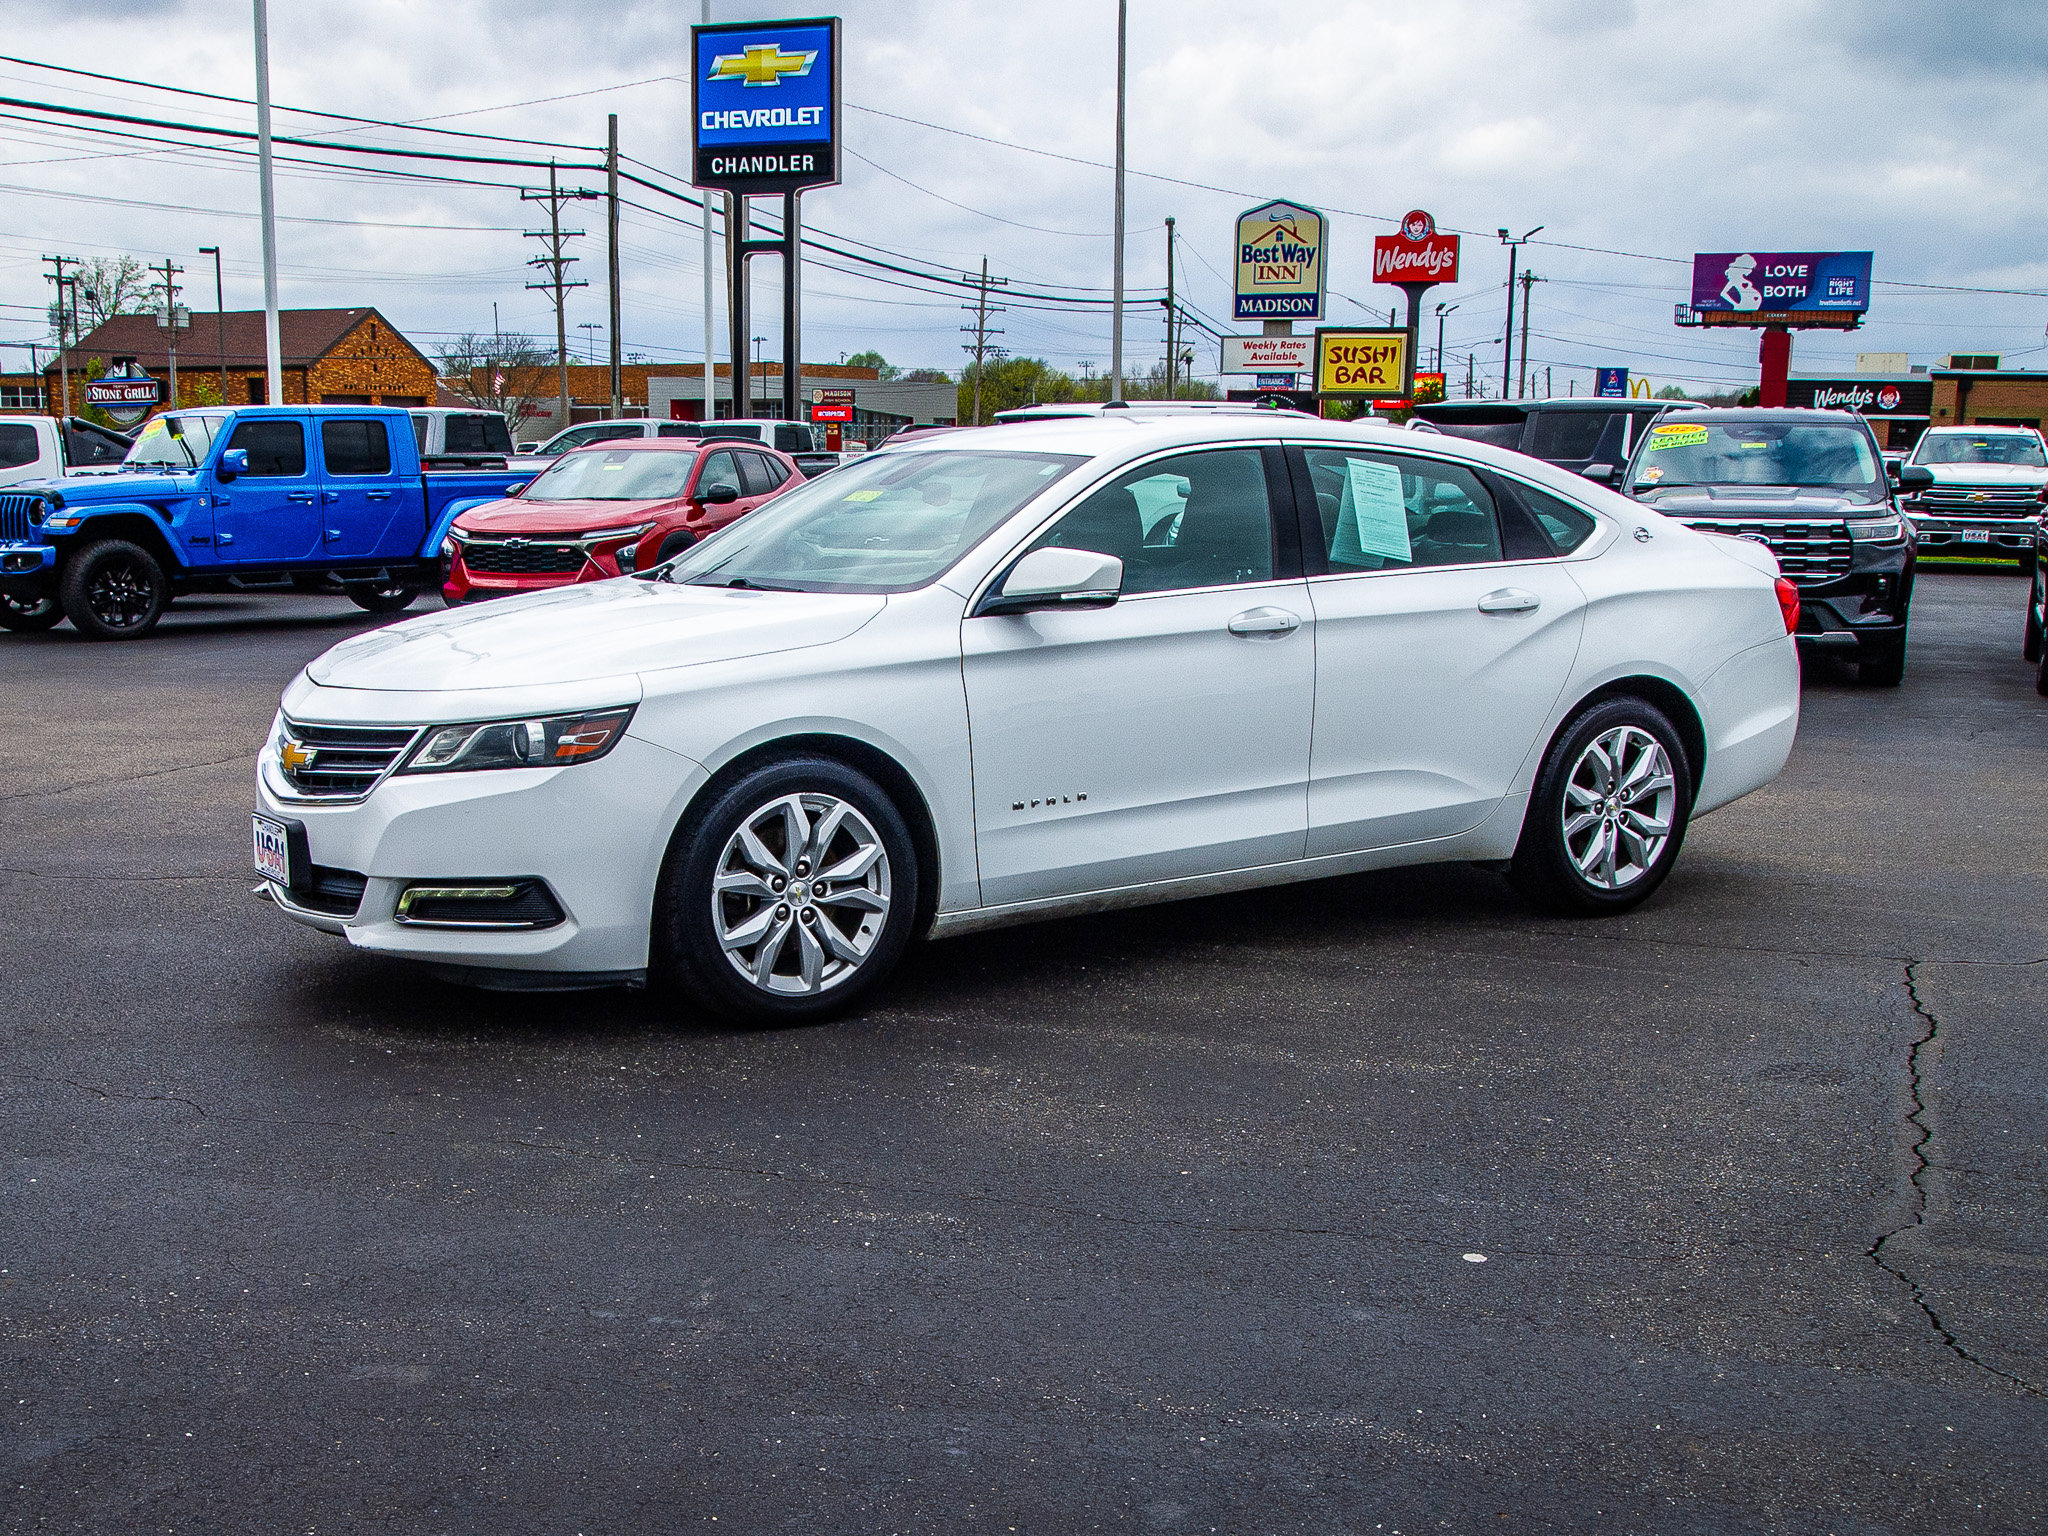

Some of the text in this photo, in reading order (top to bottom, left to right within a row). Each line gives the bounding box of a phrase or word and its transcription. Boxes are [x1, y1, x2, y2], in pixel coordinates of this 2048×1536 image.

[702, 106, 823, 130] CHEVROLET
[711, 154, 814, 174] CHANDLER
[1241, 243, 1317, 269] Best Way
[1376, 241, 1455, 276] Wendy's
[1257, 264, 1298, 281] INN
[1764, 264, 1808, 278] LOVE
[1763, 285, 1806, 298] BOTH
[1828, 287, 1854, 296] LIFE
[1239, 297, 1314, 314] MADISON
[1243, 340, 1306, 351] Weekly Rates
[1250, 352, 1298, 361] Available
[1328, 345, 1397, 365] SUSHI
[1335, 366, 1387, 385] BAR
[91, 386, 152, 400] STONE GRILL
[1813, 385, 1874, 409] Wendy's
[1658, 425, 1701, 434] 2025
[1652, 432, 1706, 444] LEATHER
[1670, 438, 1705, 447] MILEAGE
[189, 535, 211, 544] Jeep
